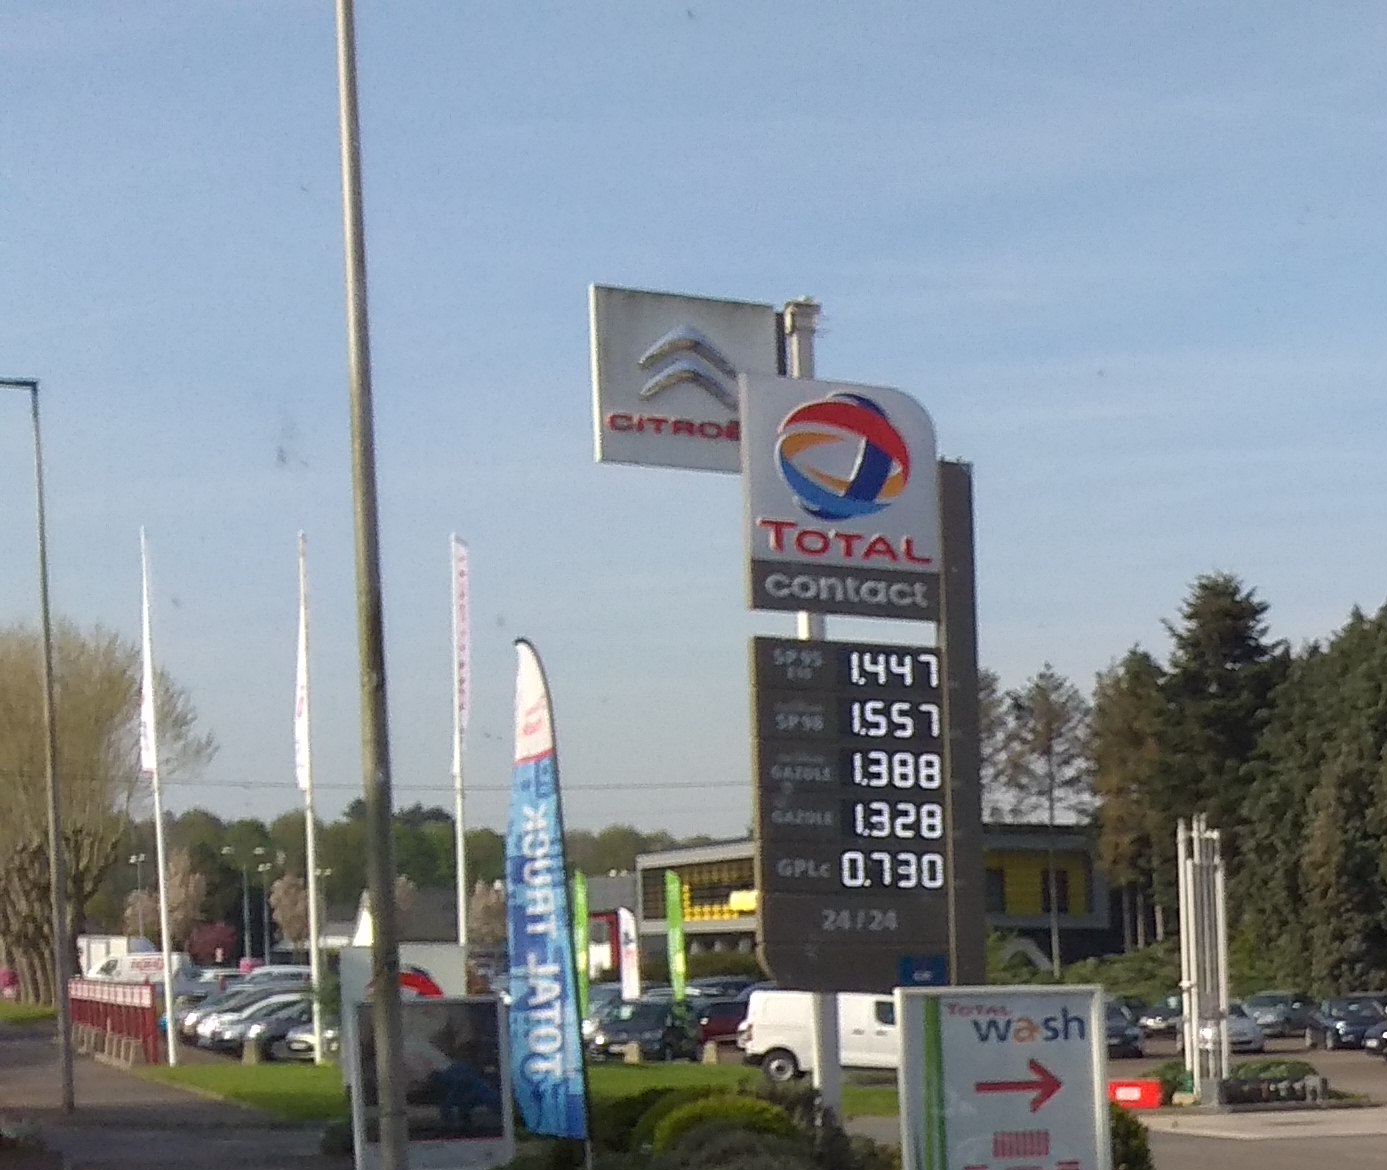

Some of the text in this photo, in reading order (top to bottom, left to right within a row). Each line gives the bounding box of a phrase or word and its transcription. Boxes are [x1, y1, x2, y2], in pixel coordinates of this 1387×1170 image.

[756, 518, 932, 564] TOTAL
[764, 572, 928, 608] contact
[851, 652, 939, 688] 1.447
[851, 700, 940, 738] 1.557
[853, 751, 942, 789] 1.388
[854, 801, 944, 839] 1.328
[841, 850, 945, 888] 0.730
[972, 1005, 1086, 1045] wash
